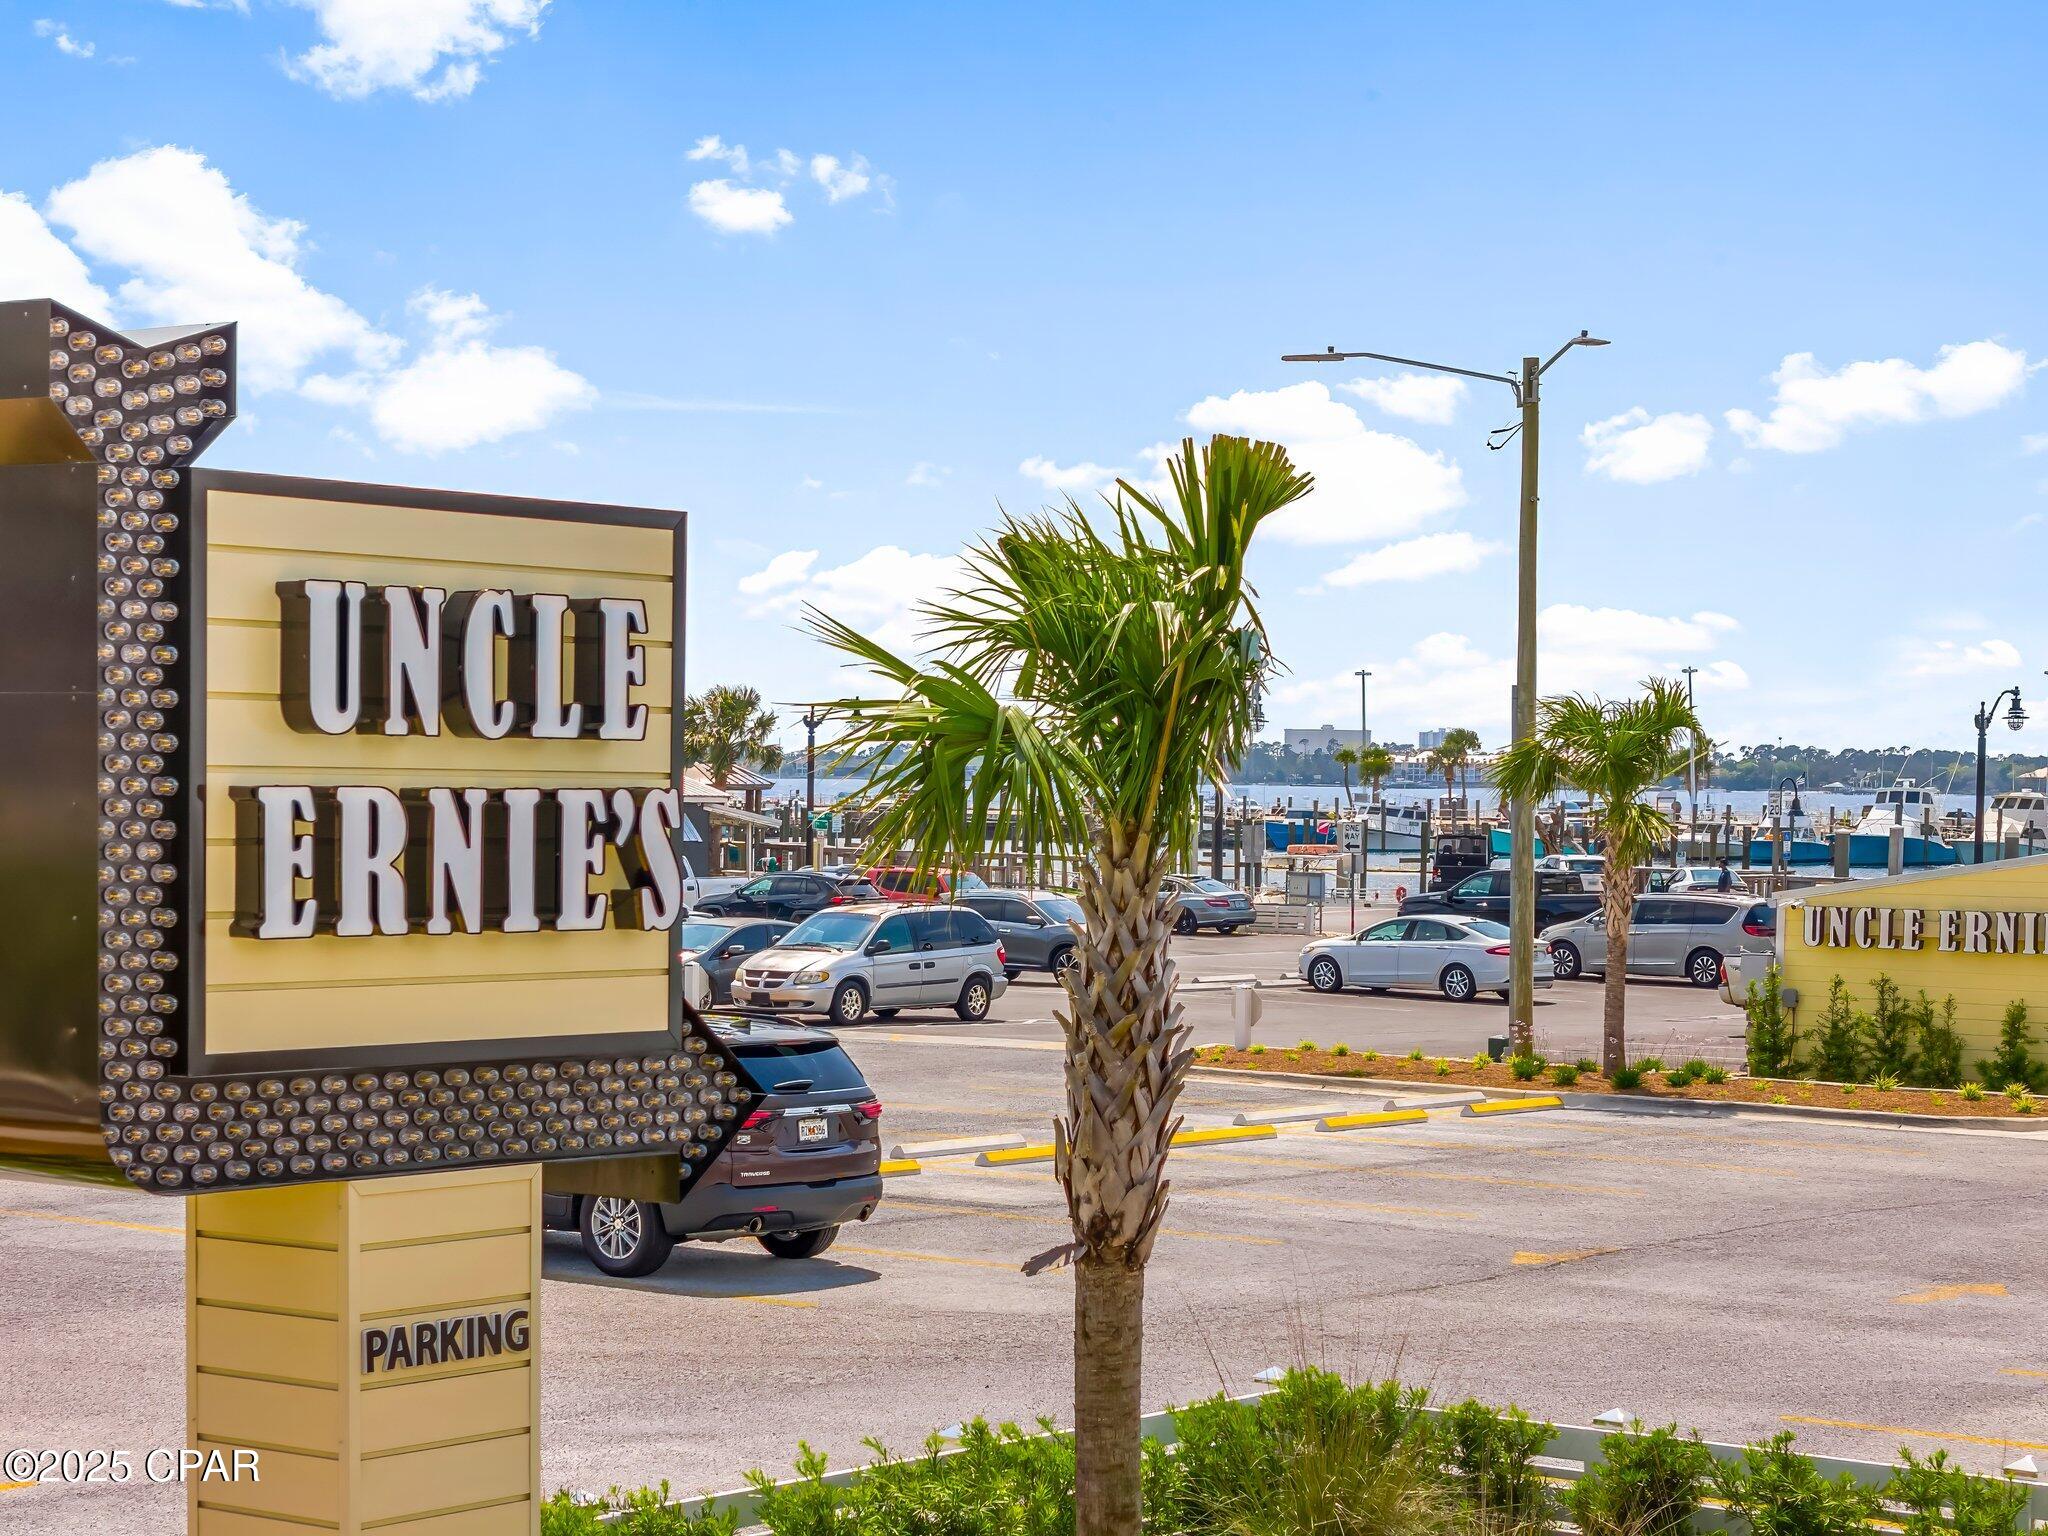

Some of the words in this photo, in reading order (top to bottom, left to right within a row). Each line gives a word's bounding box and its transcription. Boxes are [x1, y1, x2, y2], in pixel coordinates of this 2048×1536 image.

[302, 578, 649, 741] UNCLE
[1345, 824, 1360, 832] ONE
[1769, 804, 1780, 815] 20
[257, 785, 682, 940] ERNIE'S
[1803, 906, 1923, 952] UNCLE
[362, 1308, 530, 1375] PARKING
